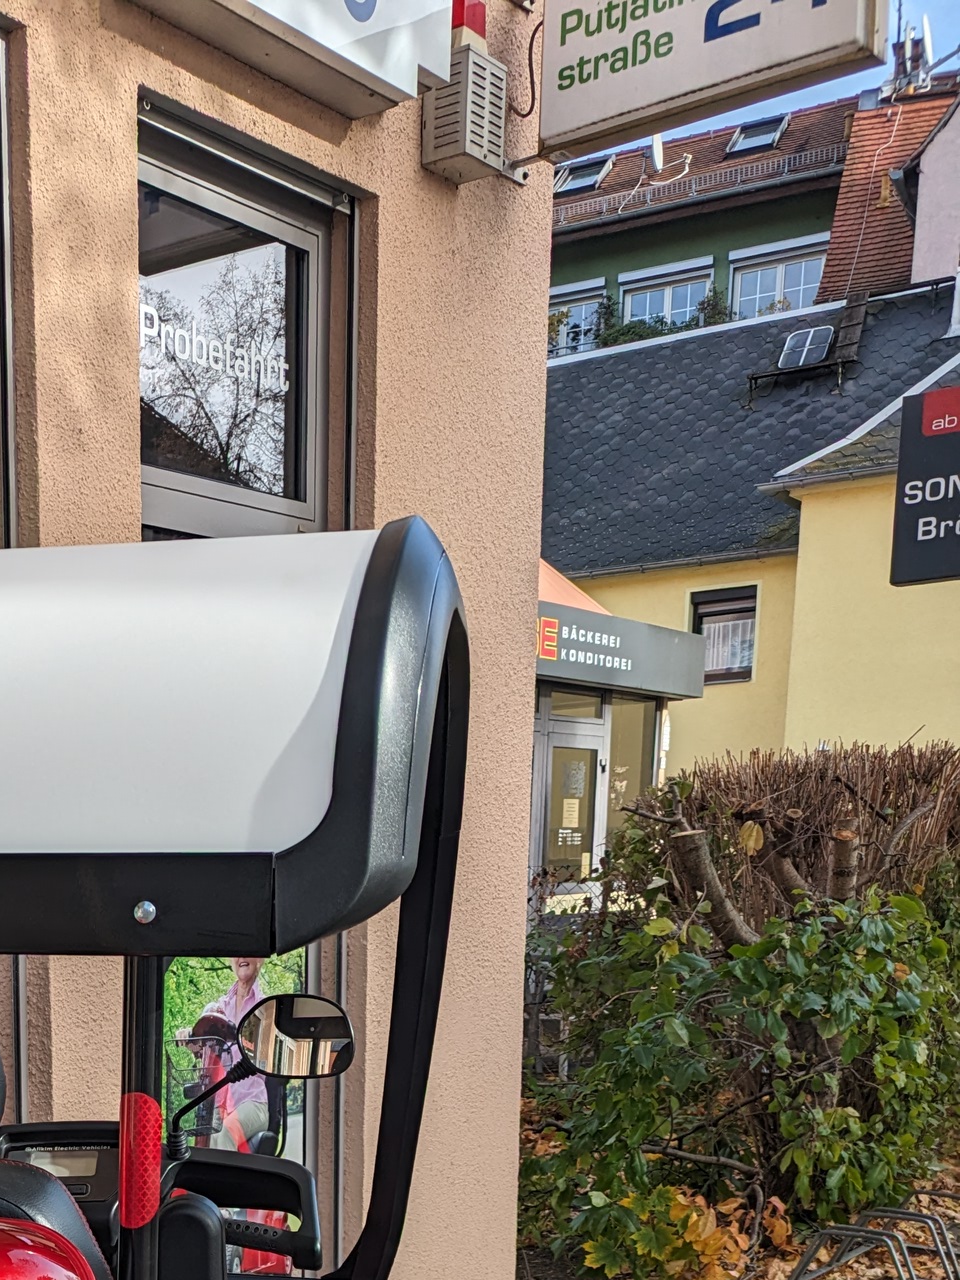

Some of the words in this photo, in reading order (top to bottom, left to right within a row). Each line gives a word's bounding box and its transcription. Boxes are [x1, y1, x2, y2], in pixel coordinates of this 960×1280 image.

[560, 0, 693, 47] Putja
[557, 29, 674, 91] straße
[139, 303, 290, 392] Probefahrt
[931, 414, 958, 431] ab
[561, 625, 620, 648] BÄCKEREI
[560, 648, 632, 671] KONDITOREI
